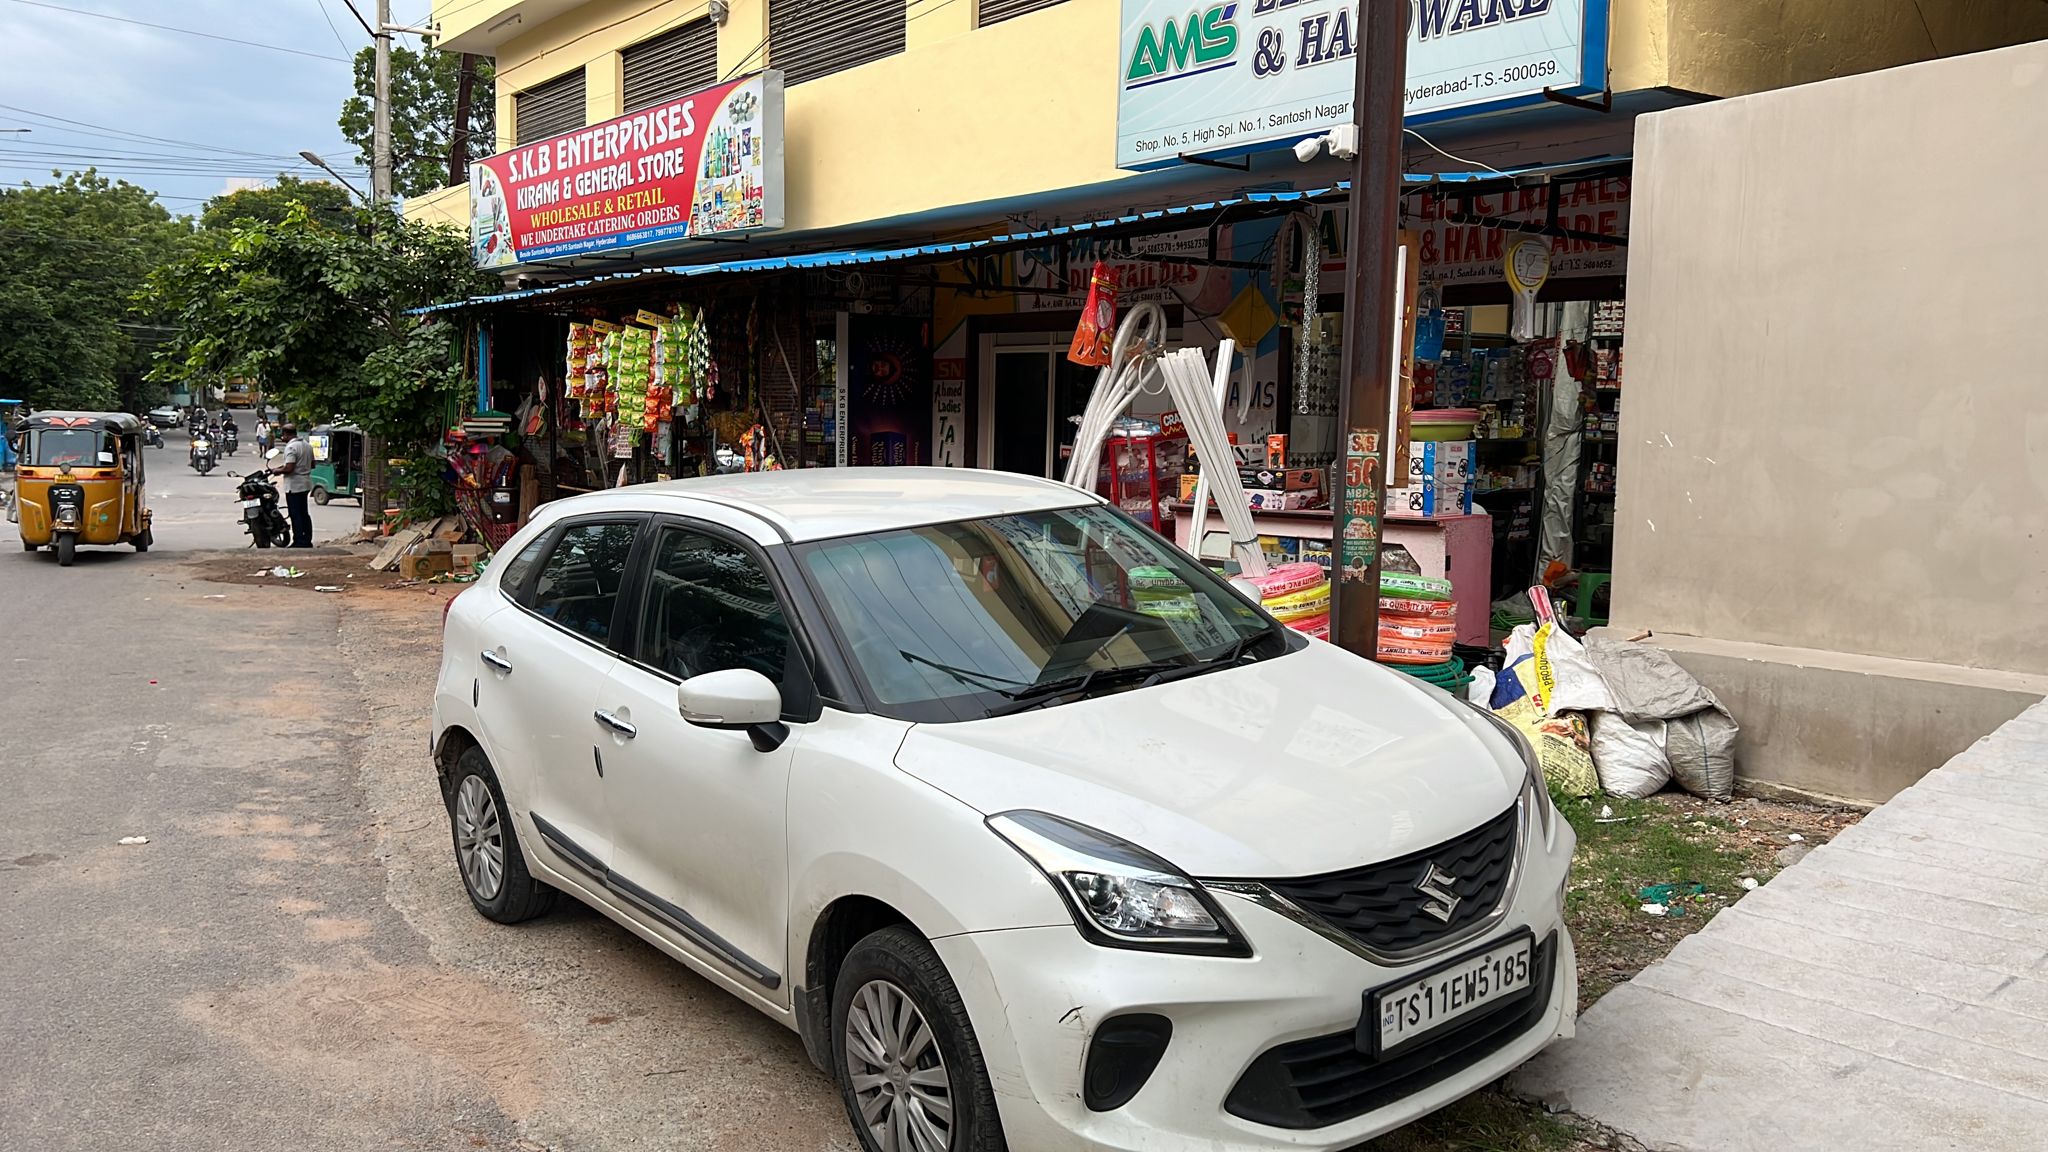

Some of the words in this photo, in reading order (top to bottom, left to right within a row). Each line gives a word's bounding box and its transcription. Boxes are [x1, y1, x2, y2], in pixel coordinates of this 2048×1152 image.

[1126, 3, 1238, 81] AMS
[1253, 27, 1285, 78] &
[509, 144, 551, 184] S.K.B
[557, 100, 695, 170] ENTERPRISES
[1136, 139, 1160, 153] Shop.
[1163, 135, 1179, 148] No.
[1193, 128, 1215, 143] High
[1217, 124, 1235, 139] Spl.
[1268, 110, 1311, 127] Santosh
[1315, 102, 1349, 120] Nagar
[517, 178, 560, 211] KIRANA
[563, 176, 572, 201] &
[576, 164, 635, 197] GENERAL
[638, 147, 684, 183] STORE
[520, 232, 535, 248] WE
[535, 223, 587, 244] UNDERTAKE
[588, 213, 635, 235] CATERING
[637, 204, 681, 227] ORDERS
[531, 201, 601, 229] WHOLESALE
[604, 198, 614, 215] &
[617, 187, 666, 210] RETAIL
[545, 246, 556, 255] Nagar
[568, 242, 583, 251] Santosh
[596, 236, 617, 248] Hyderabad
[1420, 229, 1440, 265] &
[1457, 266, 1486, 278] Santosh
[939, 361, 961, 378] SN
[937, 400, 961, 412] Ladies
[1389, 601, 1419, 610] QUALITY
[1395, 950, 1528, 1032] TS11EW5185
[1383, 1014, 1395, 1027] IND
